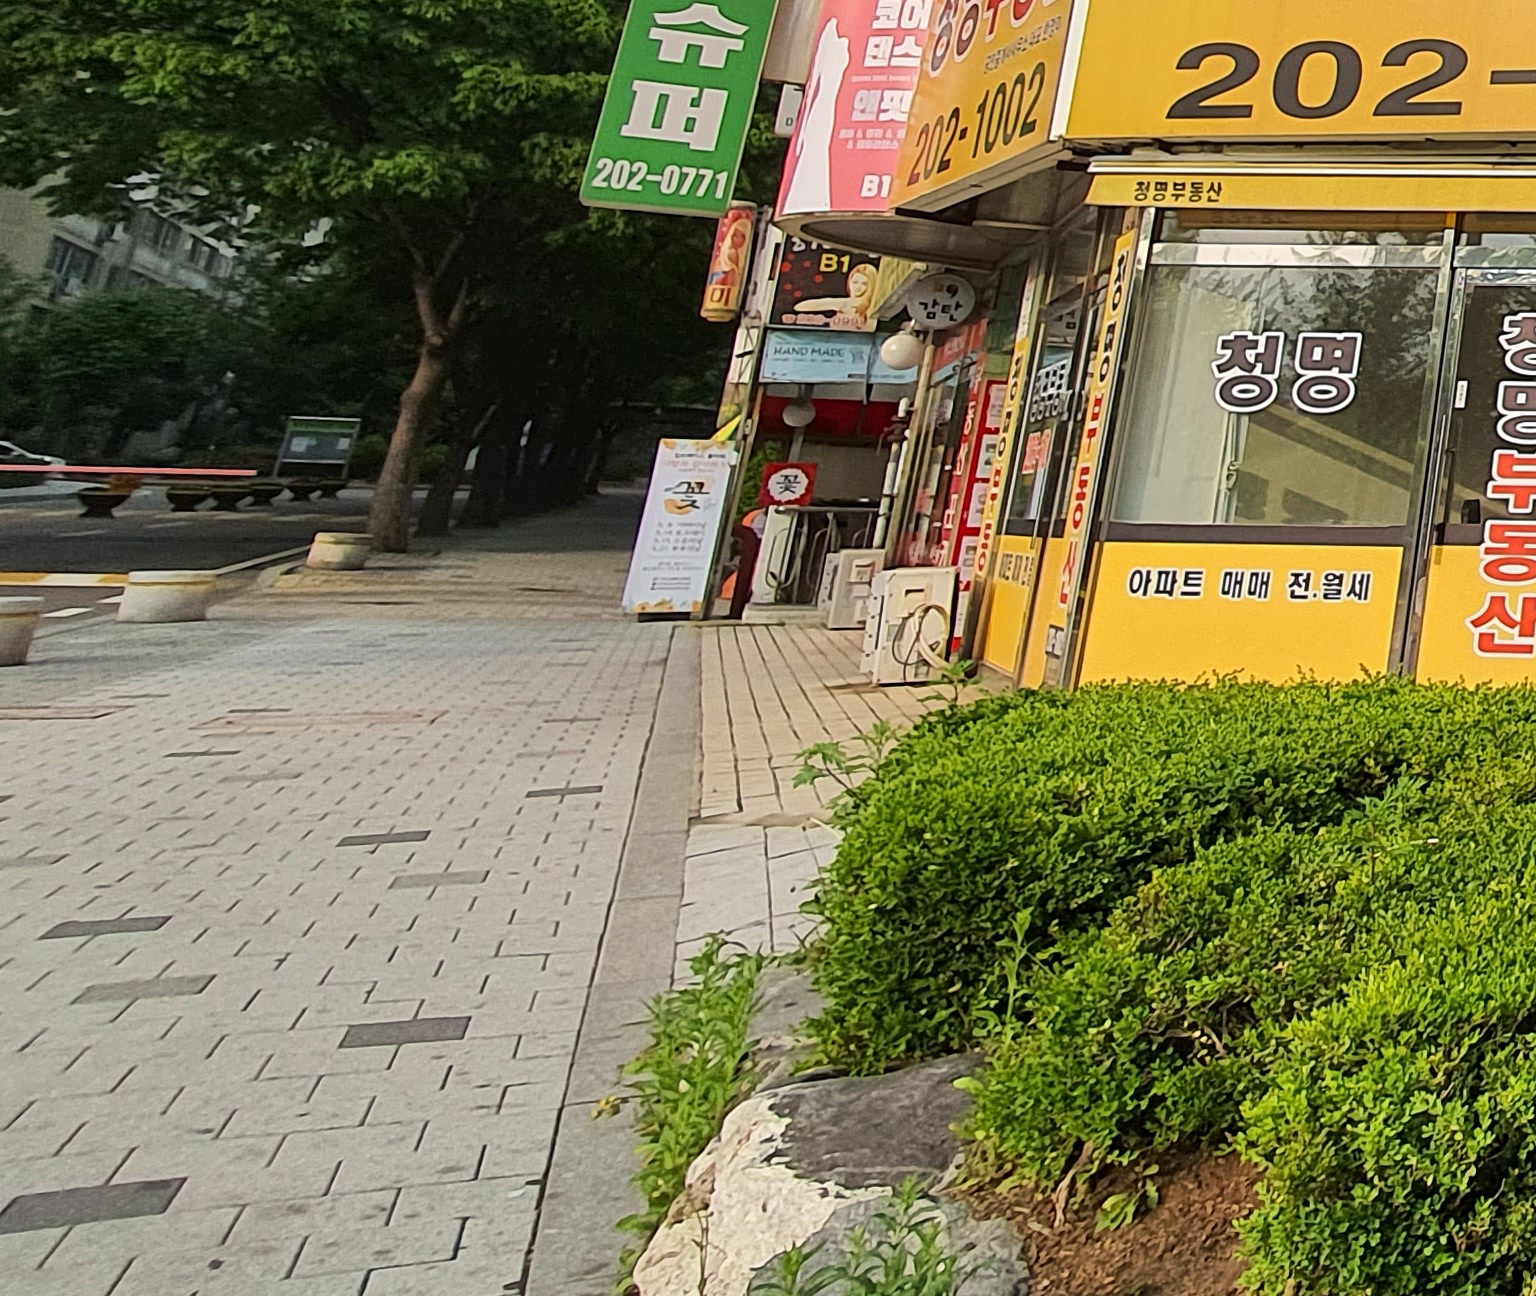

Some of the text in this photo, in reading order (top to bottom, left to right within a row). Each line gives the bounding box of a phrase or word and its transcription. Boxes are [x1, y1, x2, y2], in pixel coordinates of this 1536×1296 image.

[907, 61, 1047, 187] 202-1002
[591, 158, 729, 201] 202-0771
[860, 174, 892, 198] B1
[1133, 178, 1223, 204] 청명부동산
[819, 254, 850, 273] B1
[918, 298, 963, 322] 감탄
[773, 347, 845, 357] HAND MADE
[1212, 331, 1362, 414] 청명
[776, 474, 801, 495] 꽃
[1129, 568, 1371, 602] 아파트 매매 전.월세
